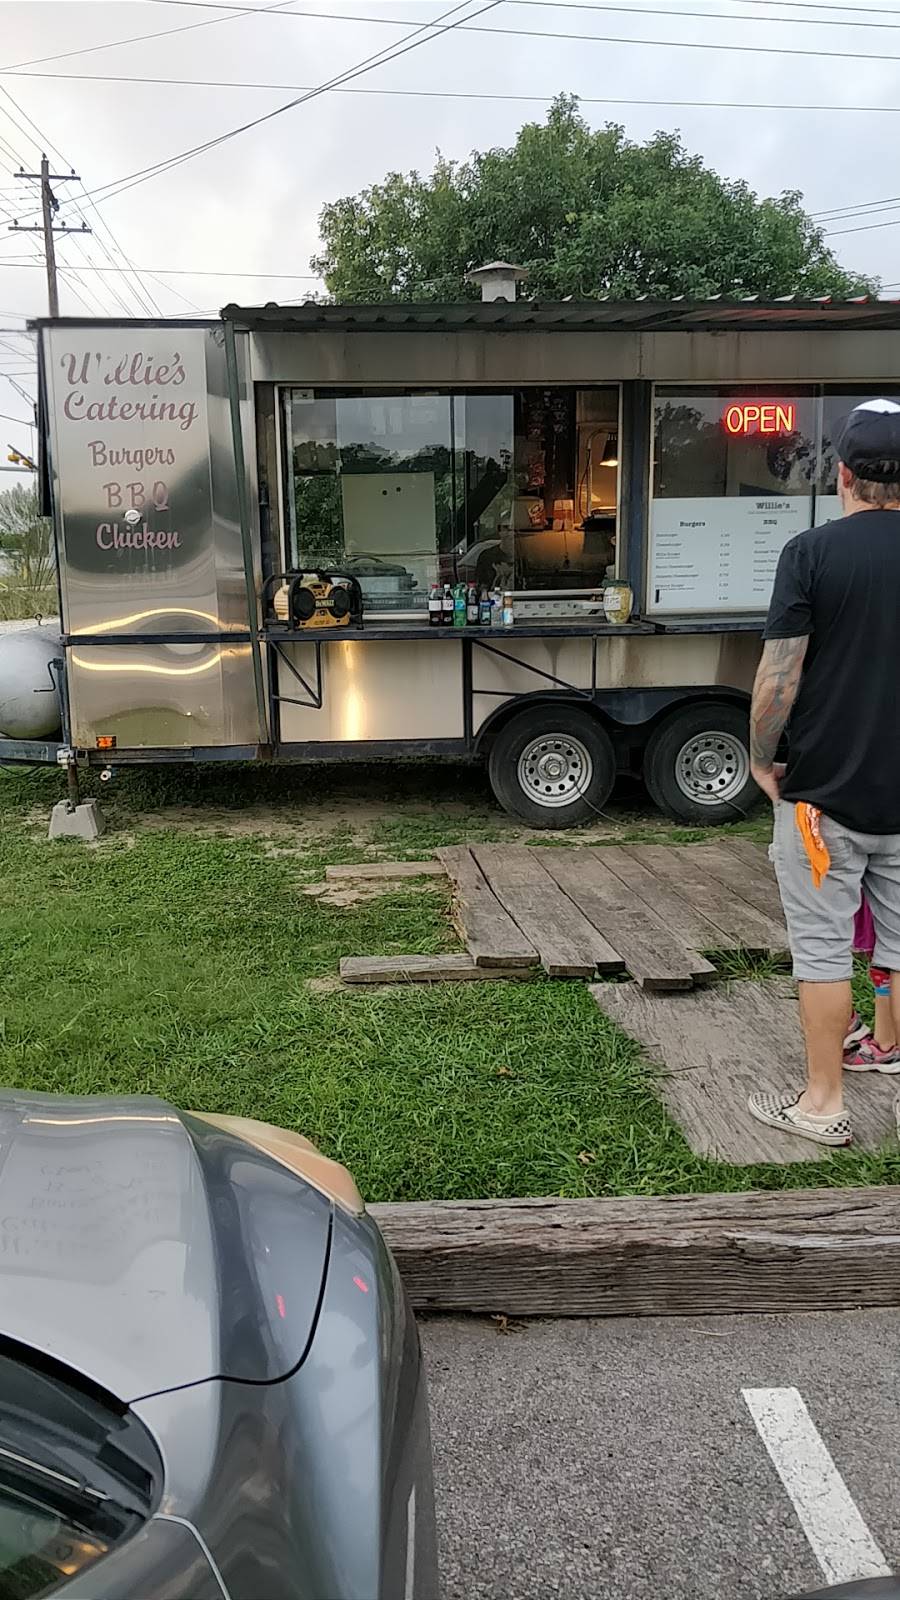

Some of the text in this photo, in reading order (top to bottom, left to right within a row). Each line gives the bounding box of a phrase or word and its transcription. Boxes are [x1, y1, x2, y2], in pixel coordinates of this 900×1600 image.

[63, 390, 199, 431] Catering
[726, 405, 793, 433] OPEN
[87, 439, 176, 472] Burgers
[755, 502, 791, 511] Willie's
[96, 523, 181, 550] Chicken
[679, 520, 706, 528] Burgers
